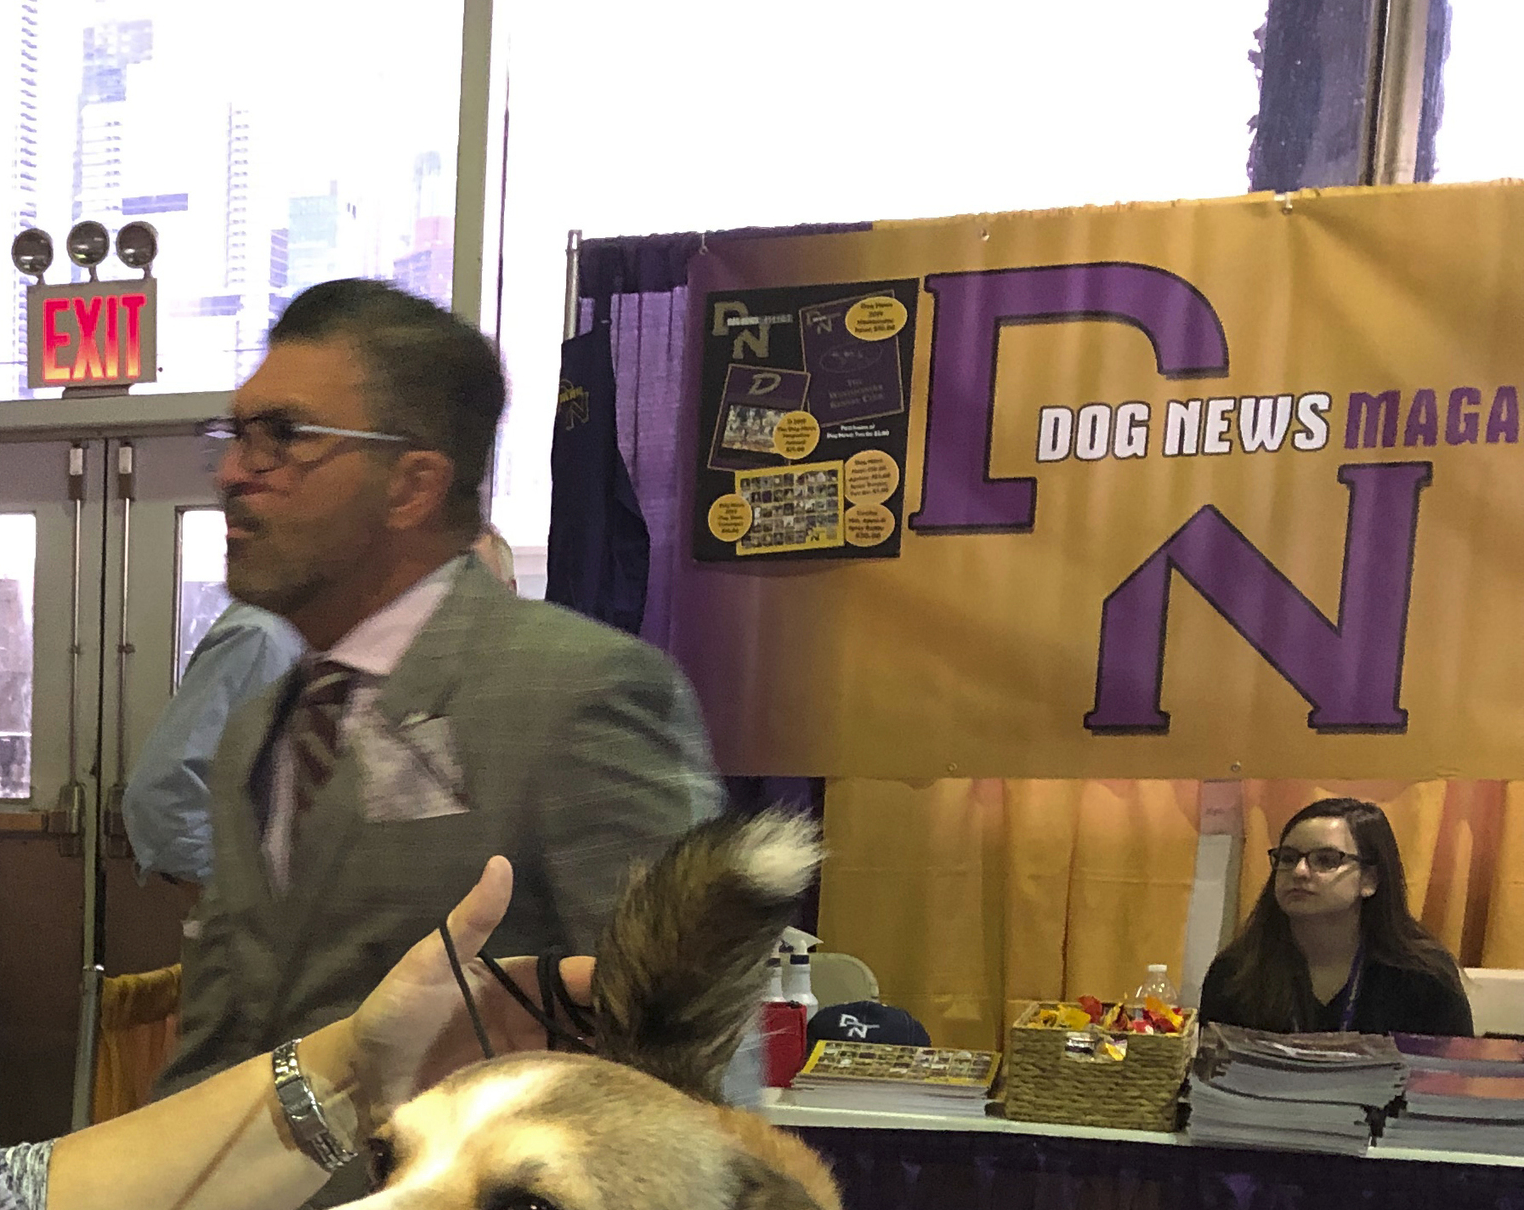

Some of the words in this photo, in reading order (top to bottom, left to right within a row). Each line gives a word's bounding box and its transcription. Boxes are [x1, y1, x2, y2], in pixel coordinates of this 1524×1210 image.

[42, 293, 147, 382] EXIT
[1035, 400, 1153, 464] DOG
[1161, 390, 1333, 458] NEWS
